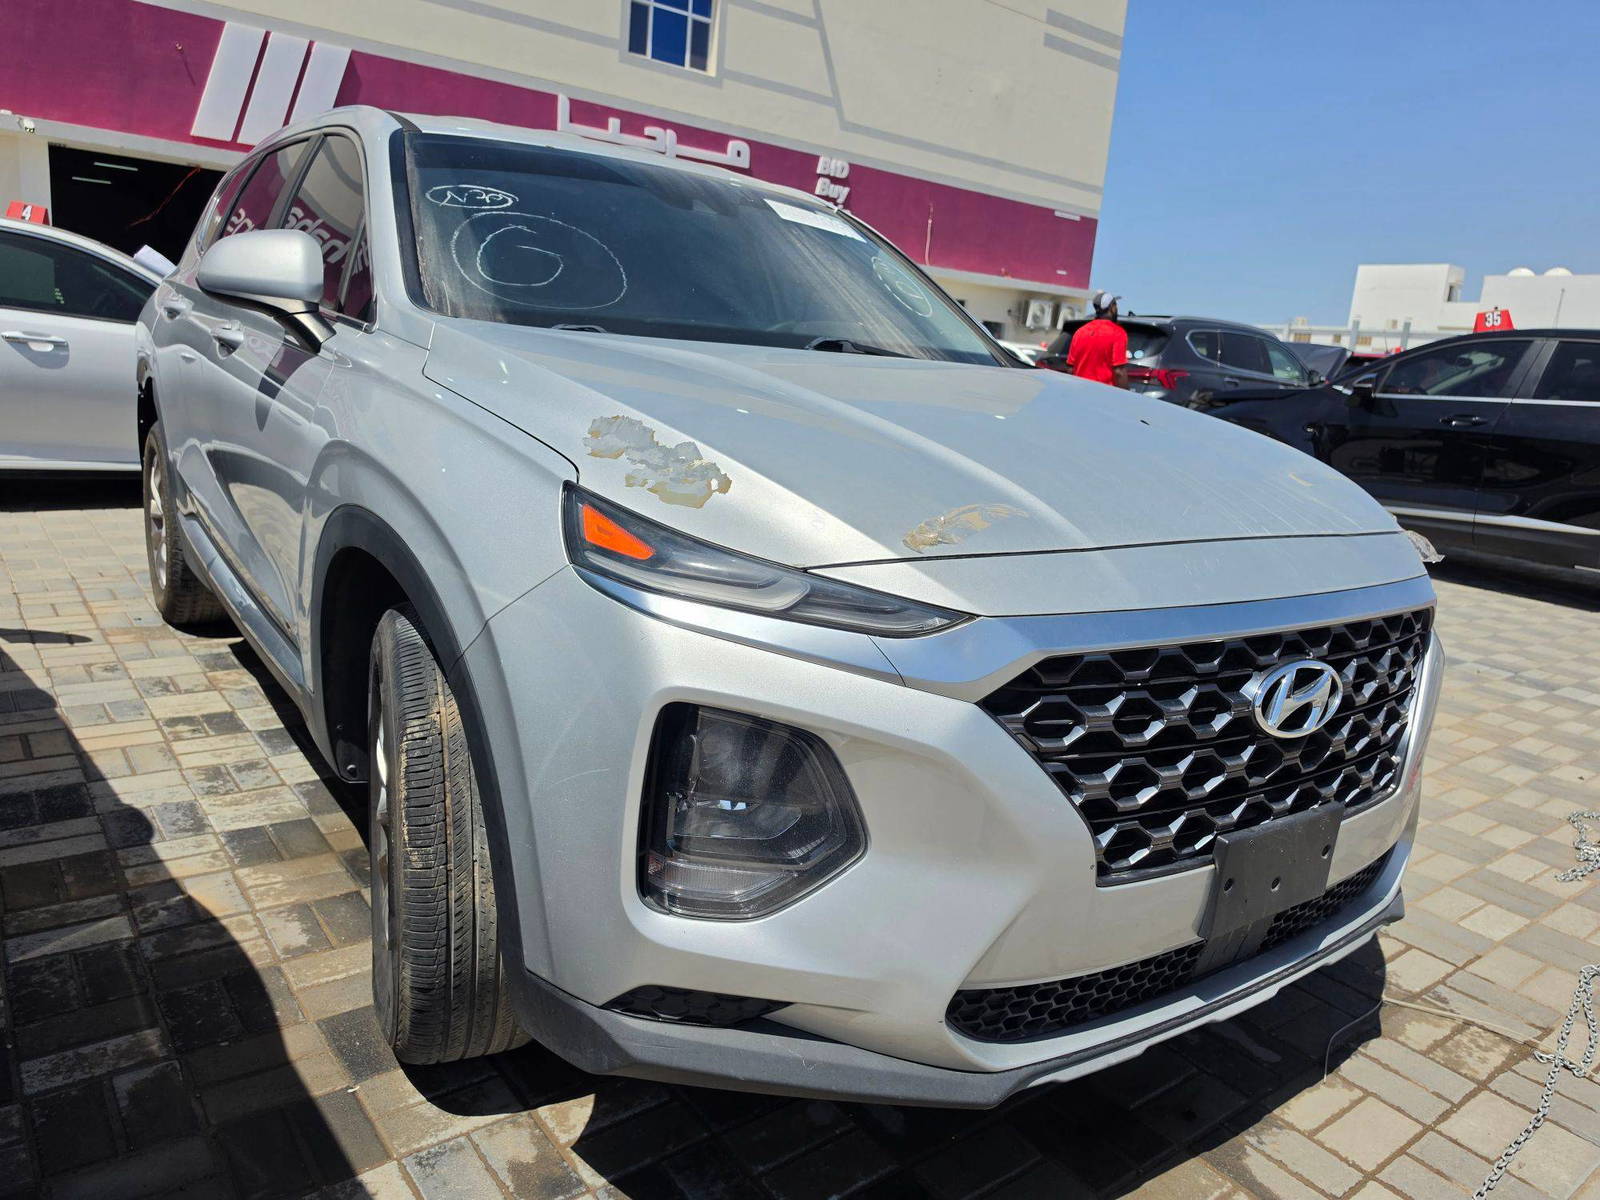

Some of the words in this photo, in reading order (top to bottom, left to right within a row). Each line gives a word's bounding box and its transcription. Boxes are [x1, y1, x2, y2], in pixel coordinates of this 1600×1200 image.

[816, 156, 849, 178] BID
[815, 177, 850, 203] Buy
[22, 205, 33, 221] 4
[1485, 311, 1501, 328] 35
